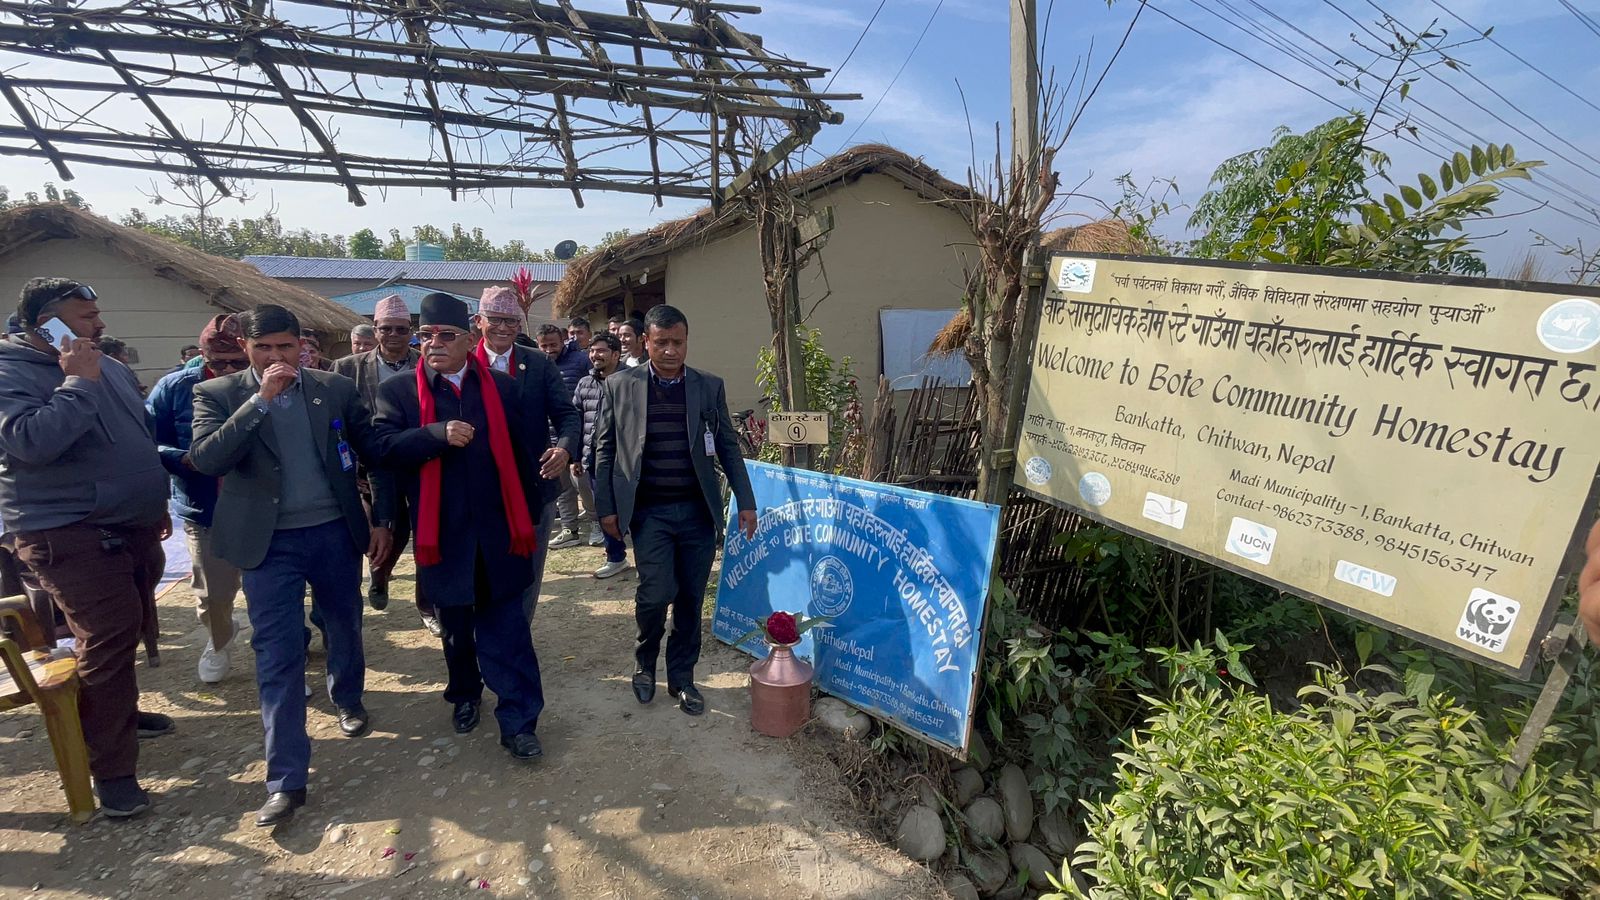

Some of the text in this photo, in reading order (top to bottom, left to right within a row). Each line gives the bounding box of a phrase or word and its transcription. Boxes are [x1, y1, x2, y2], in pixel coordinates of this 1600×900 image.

[1263, 285, 1311, 309] विविधता
[1371, 297, 1422, 319] सहयोग
[1192, 307, 1245, 351] गाउँमा
[1358, 330, 1443, 381] हार्दिक
[1444, 346, 1558, 402] स्वागत
[1037, 342, 1566, 483] Welcome to Bote Community Homestay
[1114, 405, 1336, 474] Bankatta, Chitwan, Nepal
[1111, 433, 1147, 455] चितवन
[1229, 469, 1262, 487] Madi
[1372, 507, 1454, 546] Bankatta,
[1459, 532, 1535, 567] Chitwan
[1239, 532, 1272, 552] IUCN
[900, 541, 940, 584] हार्दिक
[929, 575, 968, 630] स्वागत
[1374, 534, 1498, 582] 9845156347
[725, 540, 769, 590] WELCOME
[769, 535, 780, 548] TO
[783, 525, 812, 548] BOTE
[815, 523, 889, 572] COMMUNITY
[892, 569, 960, 673] HOMESTAY
[834, 657, 853, 672] Madi
[1459, 627, 1502, 649] WWF
